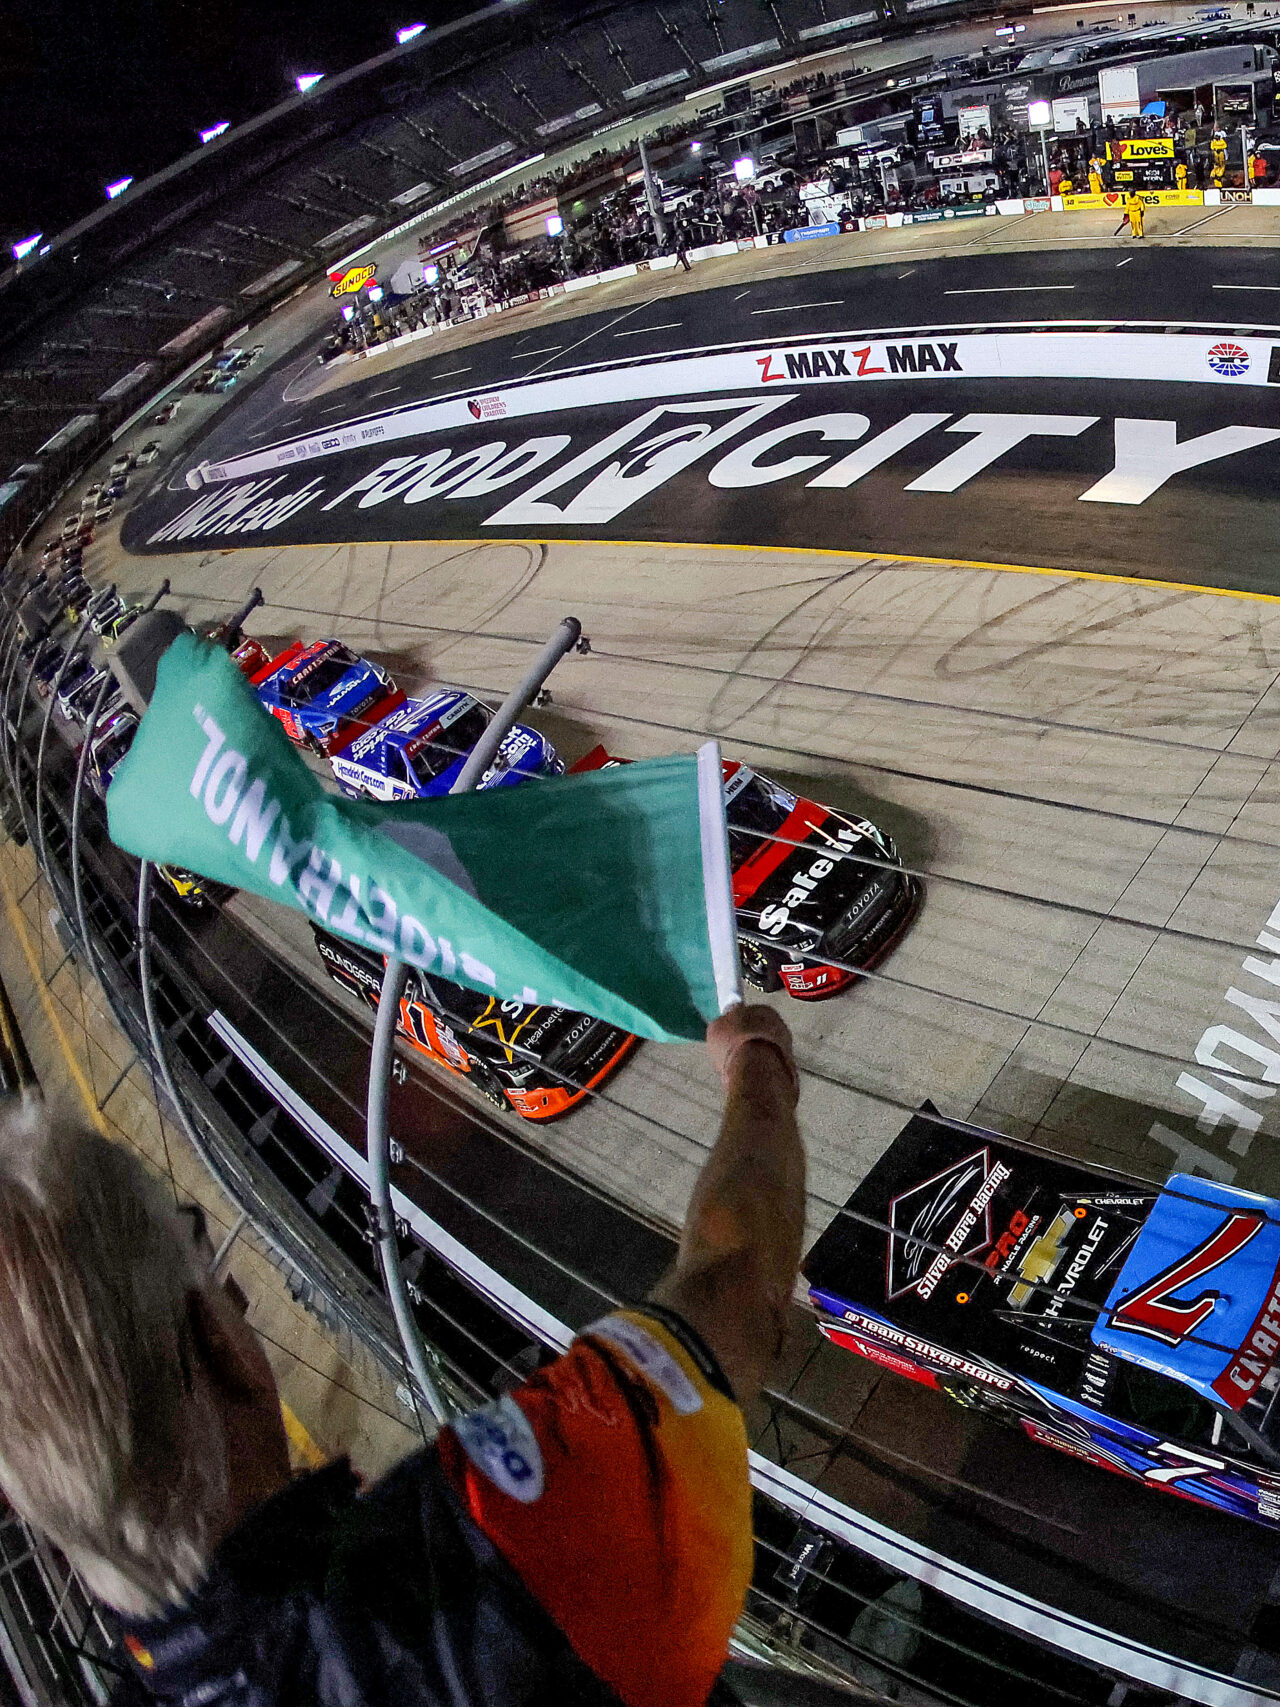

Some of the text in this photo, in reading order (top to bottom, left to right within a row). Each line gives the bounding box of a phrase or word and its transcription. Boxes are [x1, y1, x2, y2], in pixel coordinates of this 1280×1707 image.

[1129, 142, 1169, 156] Love's
[1220, 191, 1252, 203] UNOH
[771, 234, 780, 244] 5
[335, 263, 376, 295] SUNOCO
[318, 434, 570, 513] FOOD
[291, 644, 339, 686] CRAFTSMAN
[350, 696, 374, 716] TOYOTA
[444, 701, 471, 721] CARUTH
[757, 819, 883, 936] Safelite
[846, 882, 881, 920] TOYOTA
[318, 943, 383, 994] SOUNDGEAR
[815, 972, 828, 986] 11
[522, 1004, 565, 1050] Hear bette
[564, 1016, 593, 1044] TOYO
[1094, 1198, 1145, 1207] CHEVROLET
[916, 1160, 1008, 1300] Silver Hare Racing
[993, 1214, 1041, 1285] PINACLE RACING
[1040, 1216, 1109, 1328] HEVROLET
[1106, 1211, 1264, 1347] 7
[1019, 1343, 1056, 1365] respect.
[1142, 1440, 1227, 1483] 7
